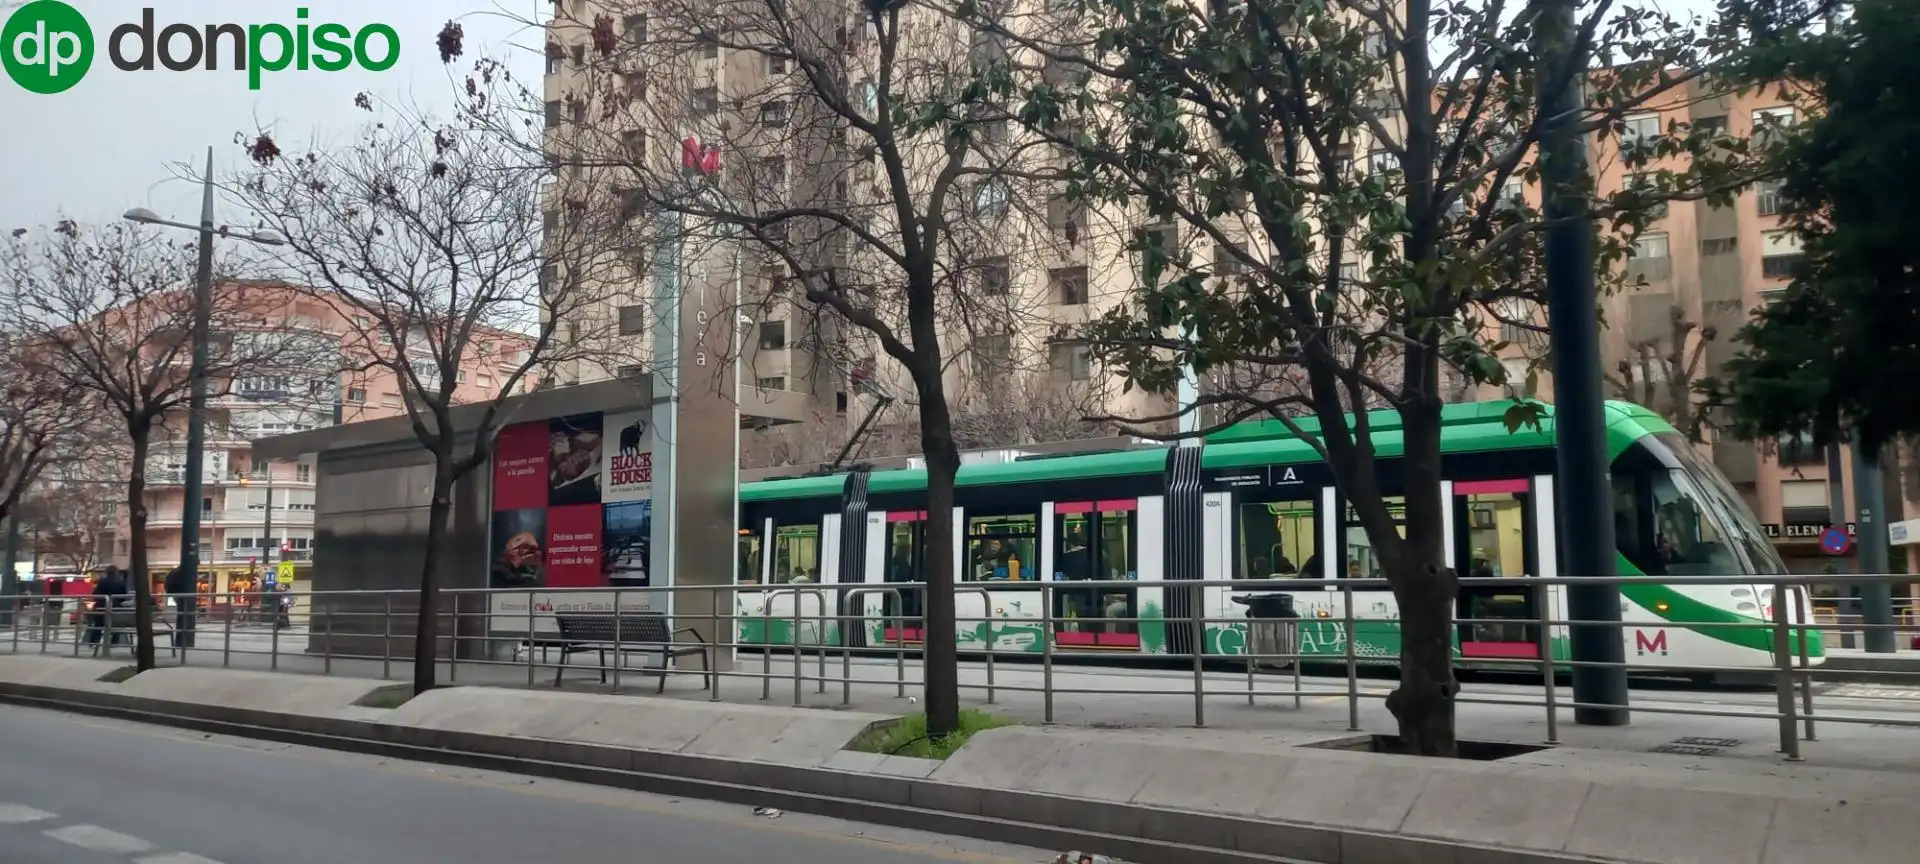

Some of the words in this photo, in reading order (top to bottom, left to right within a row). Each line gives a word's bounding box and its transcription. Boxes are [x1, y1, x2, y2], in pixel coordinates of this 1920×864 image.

[696, 266, 707, 367] aleta
[610, 452, 652, 470] BLOCK
[610, 468, 652, 486] HOUSE
[1636, 629, 1667, 656] M
